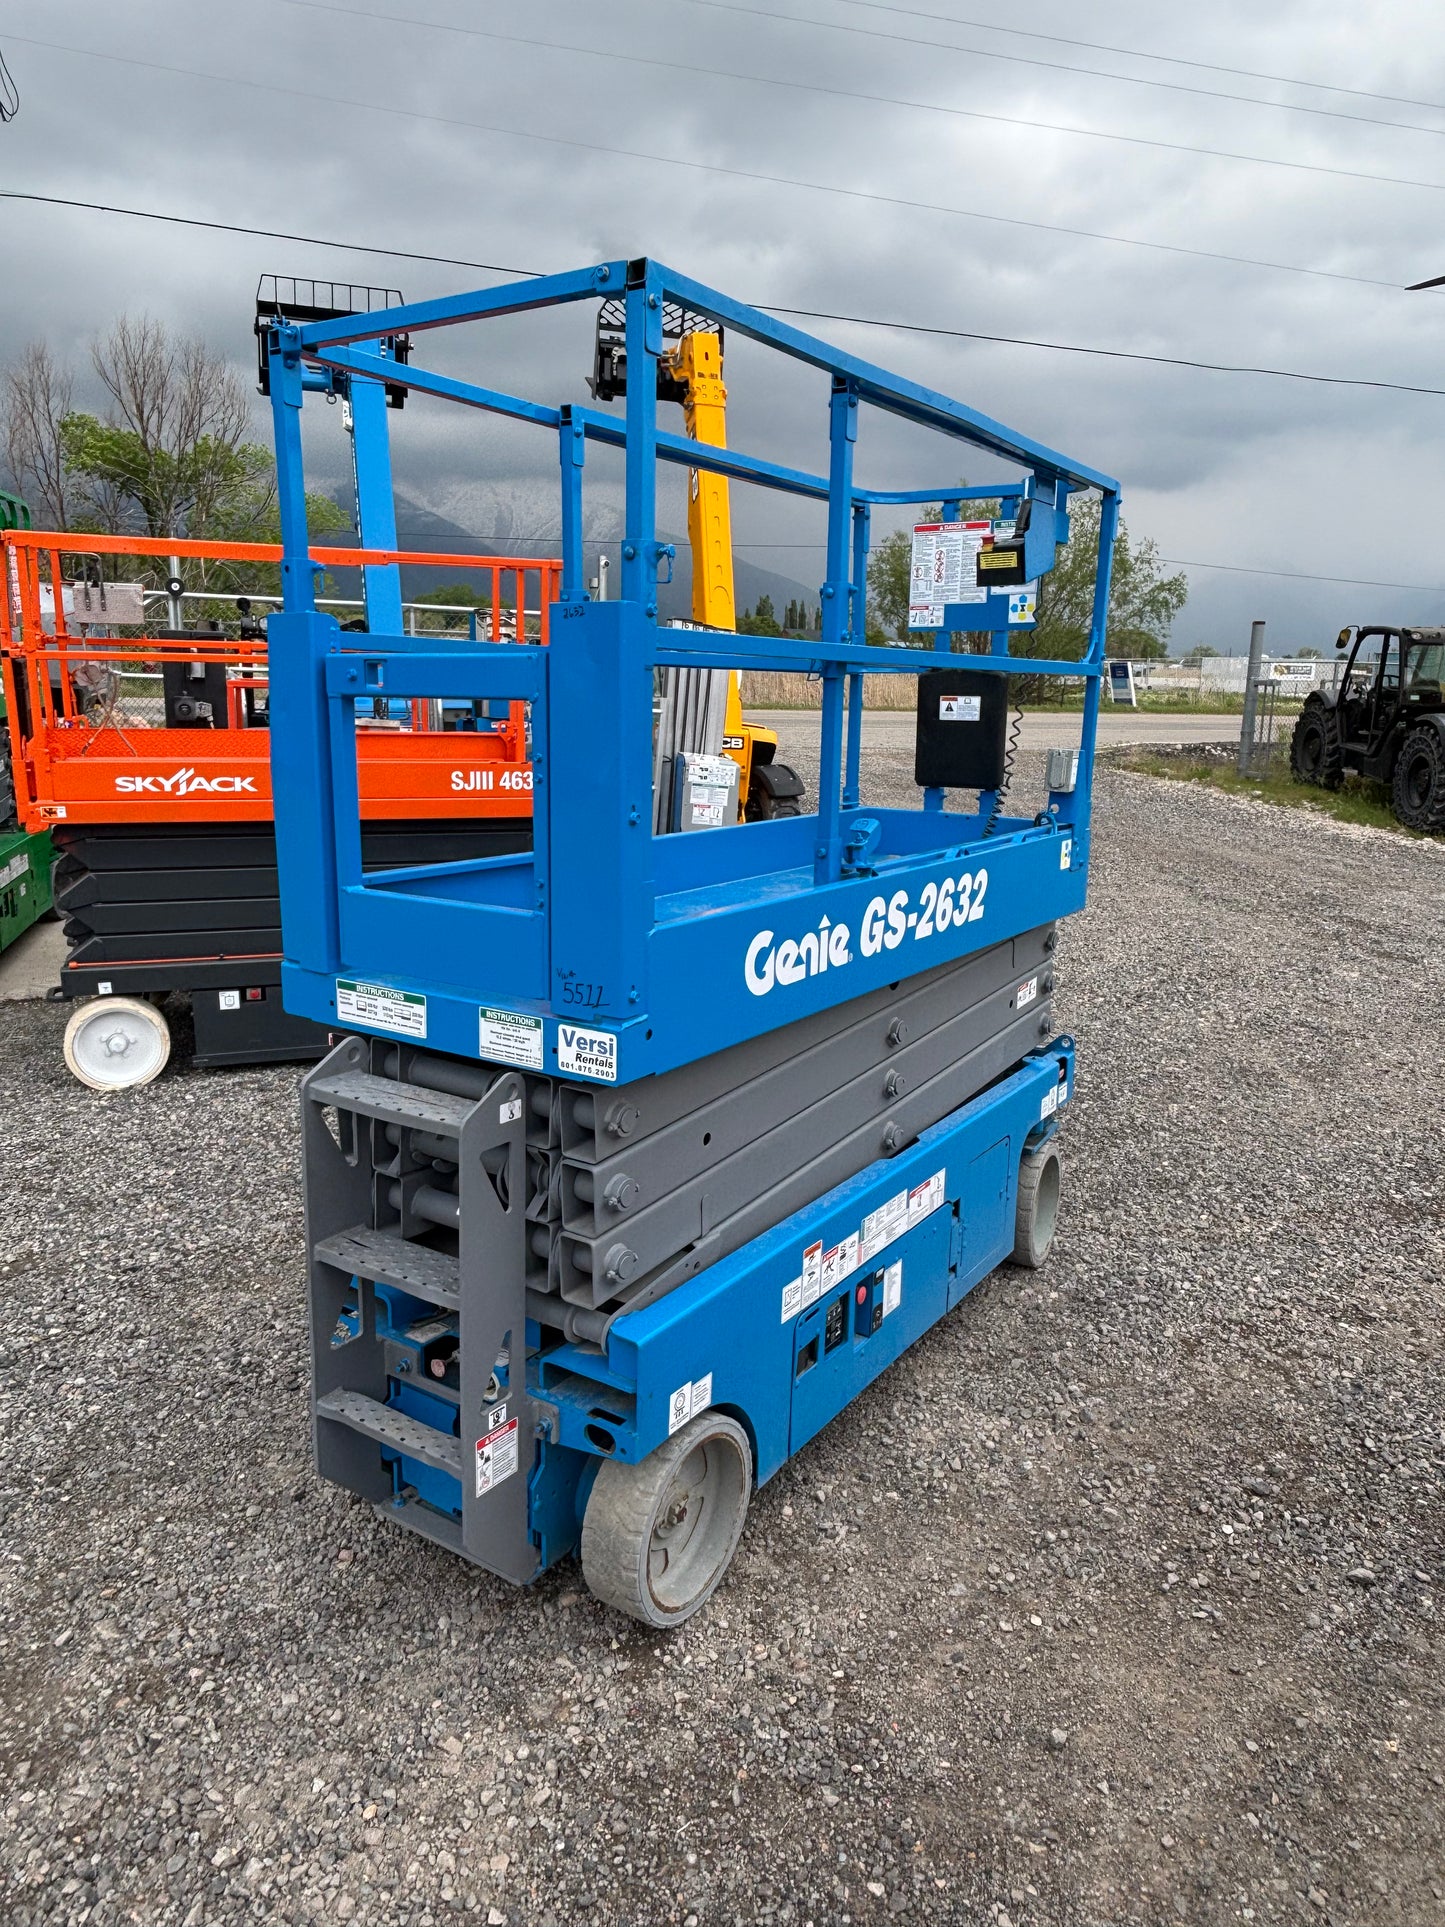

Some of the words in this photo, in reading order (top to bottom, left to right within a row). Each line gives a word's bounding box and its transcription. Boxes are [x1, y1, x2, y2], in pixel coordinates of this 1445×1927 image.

[115, 768, 258, 795] SKYJACK
[451, 771, 494, 790] SJIII
[744, 914, 850, 996] Genie
[859, 868, 989, 958] GS-2632
[356, 984, 405, 1001] INSTRUCTIONS
[563, 982, 610, 1009] 5511
[486, 1010, 536, 1027] INSTRUCTIONS
[562, 1028, 614, 1057] Versi
[575, 1052, 614, 1069] Rentals
